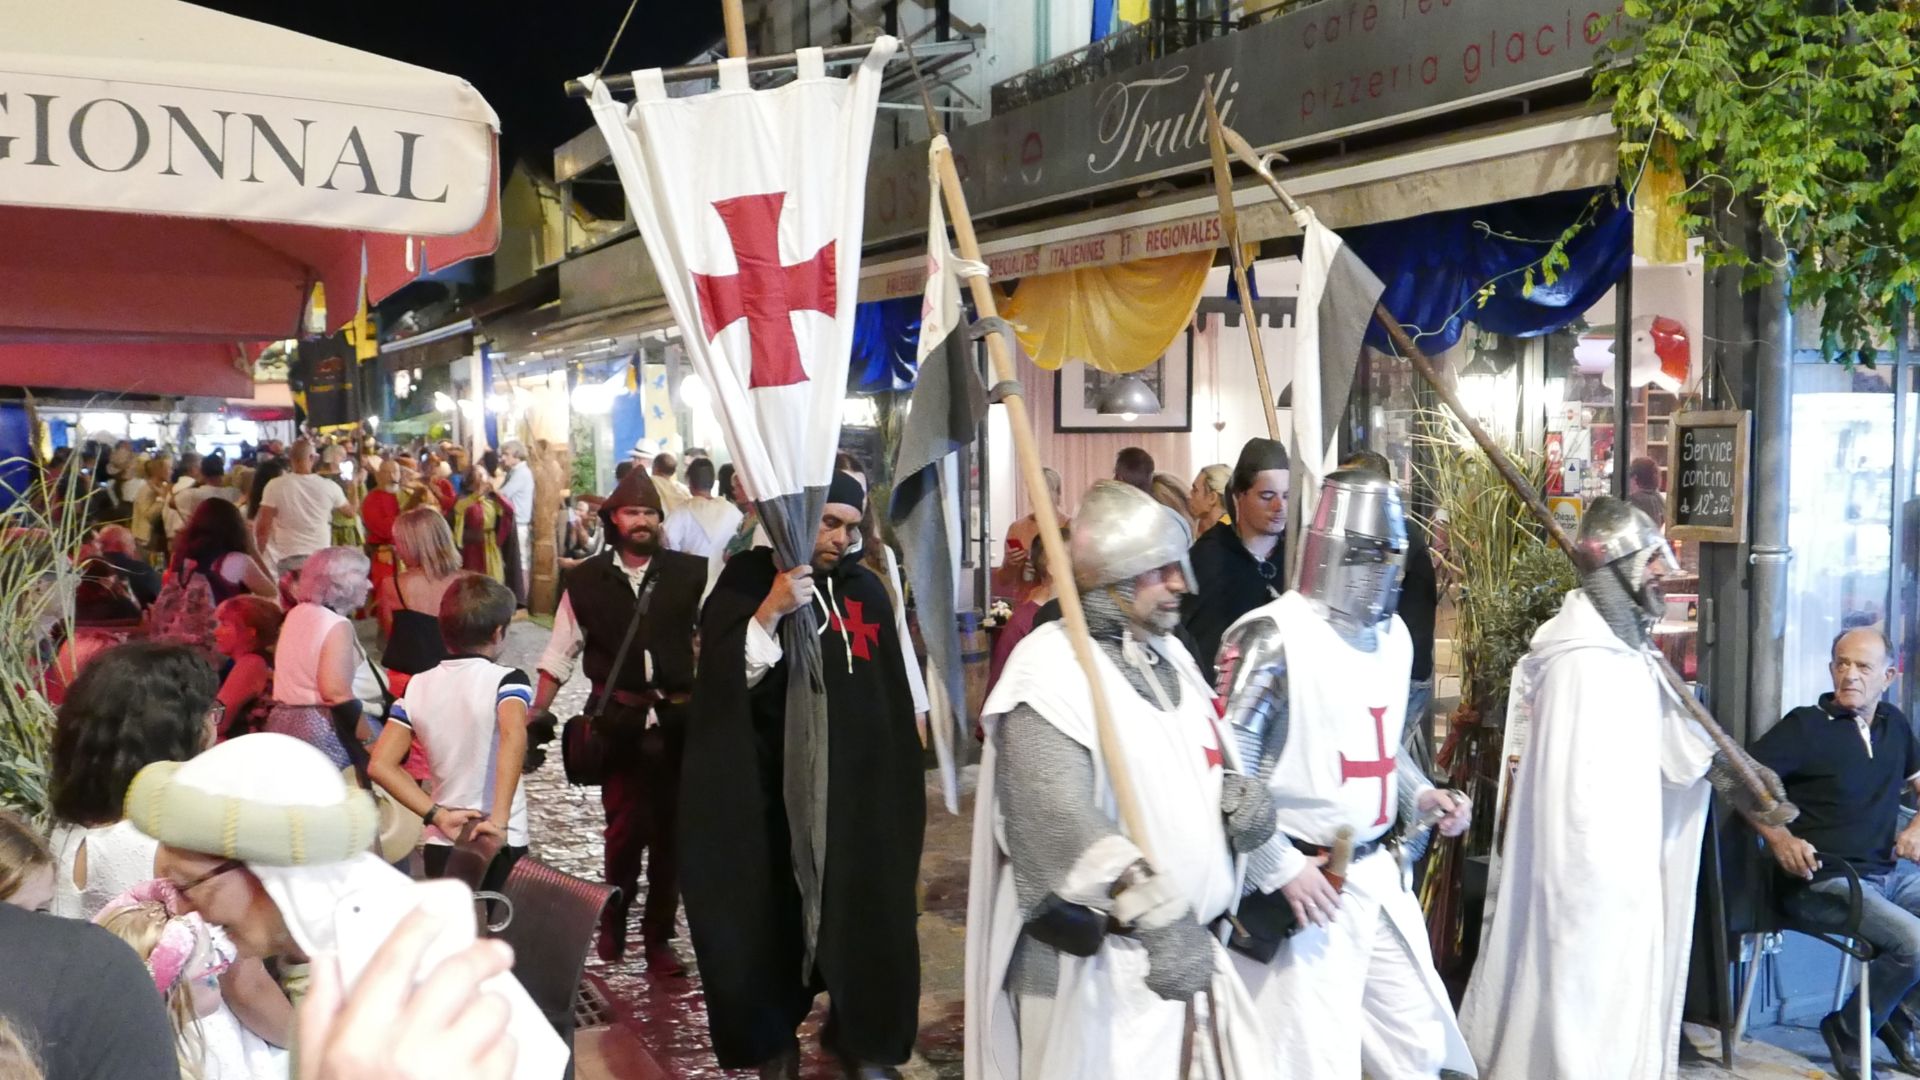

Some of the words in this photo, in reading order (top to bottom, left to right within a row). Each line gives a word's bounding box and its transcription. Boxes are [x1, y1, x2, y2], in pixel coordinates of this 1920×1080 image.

[1300, 54, 1438, 121] pizzeria
[1088, 65, 1240, 174] Trulli
[1050, 239, 1105, 268] ITALIENNES
[1146, 217, 1221, 252] REGIONALES
[1683, 432, 1733, 462] Service
[1682, 463, 1731, 488] continu
[1680, 497, 1690, 514] de
